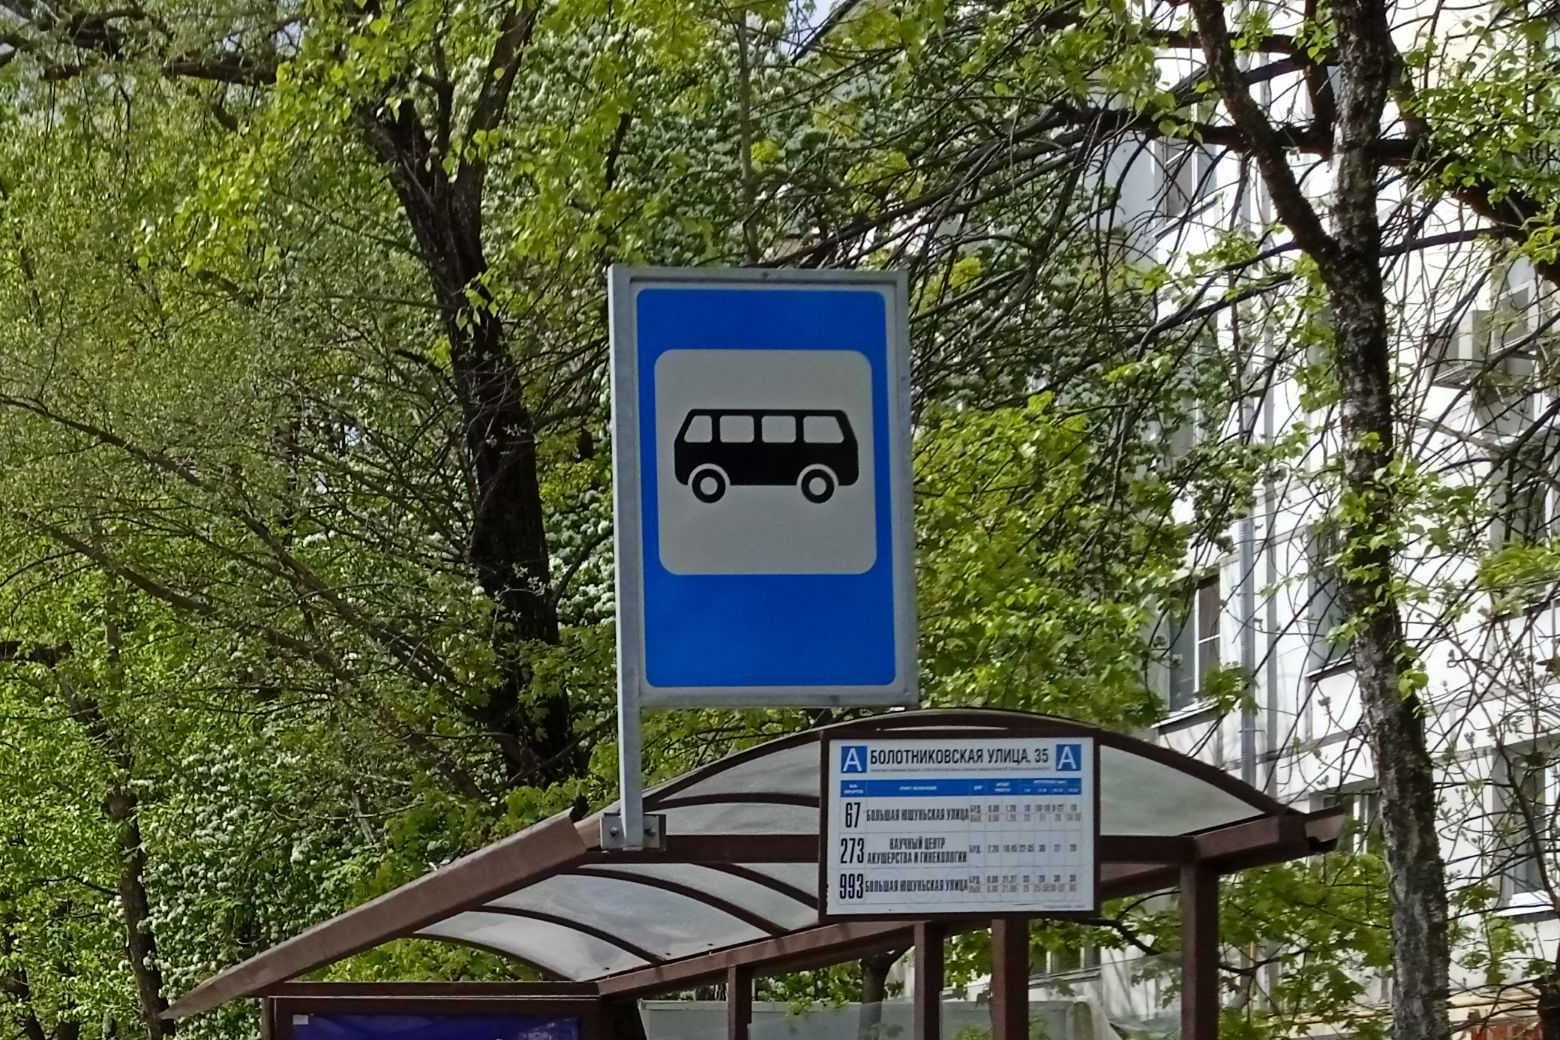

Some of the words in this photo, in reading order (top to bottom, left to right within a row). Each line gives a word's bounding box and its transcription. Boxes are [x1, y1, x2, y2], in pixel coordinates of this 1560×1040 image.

[870, 748, 984, 765] БОЛОТНИКОВСКАЯ
[1034, 748, 1049, 763] 35
[845, 802, 862, 828] 67
[840, 837, 865, 864] 273
[840, 873, 864, 899] 993
